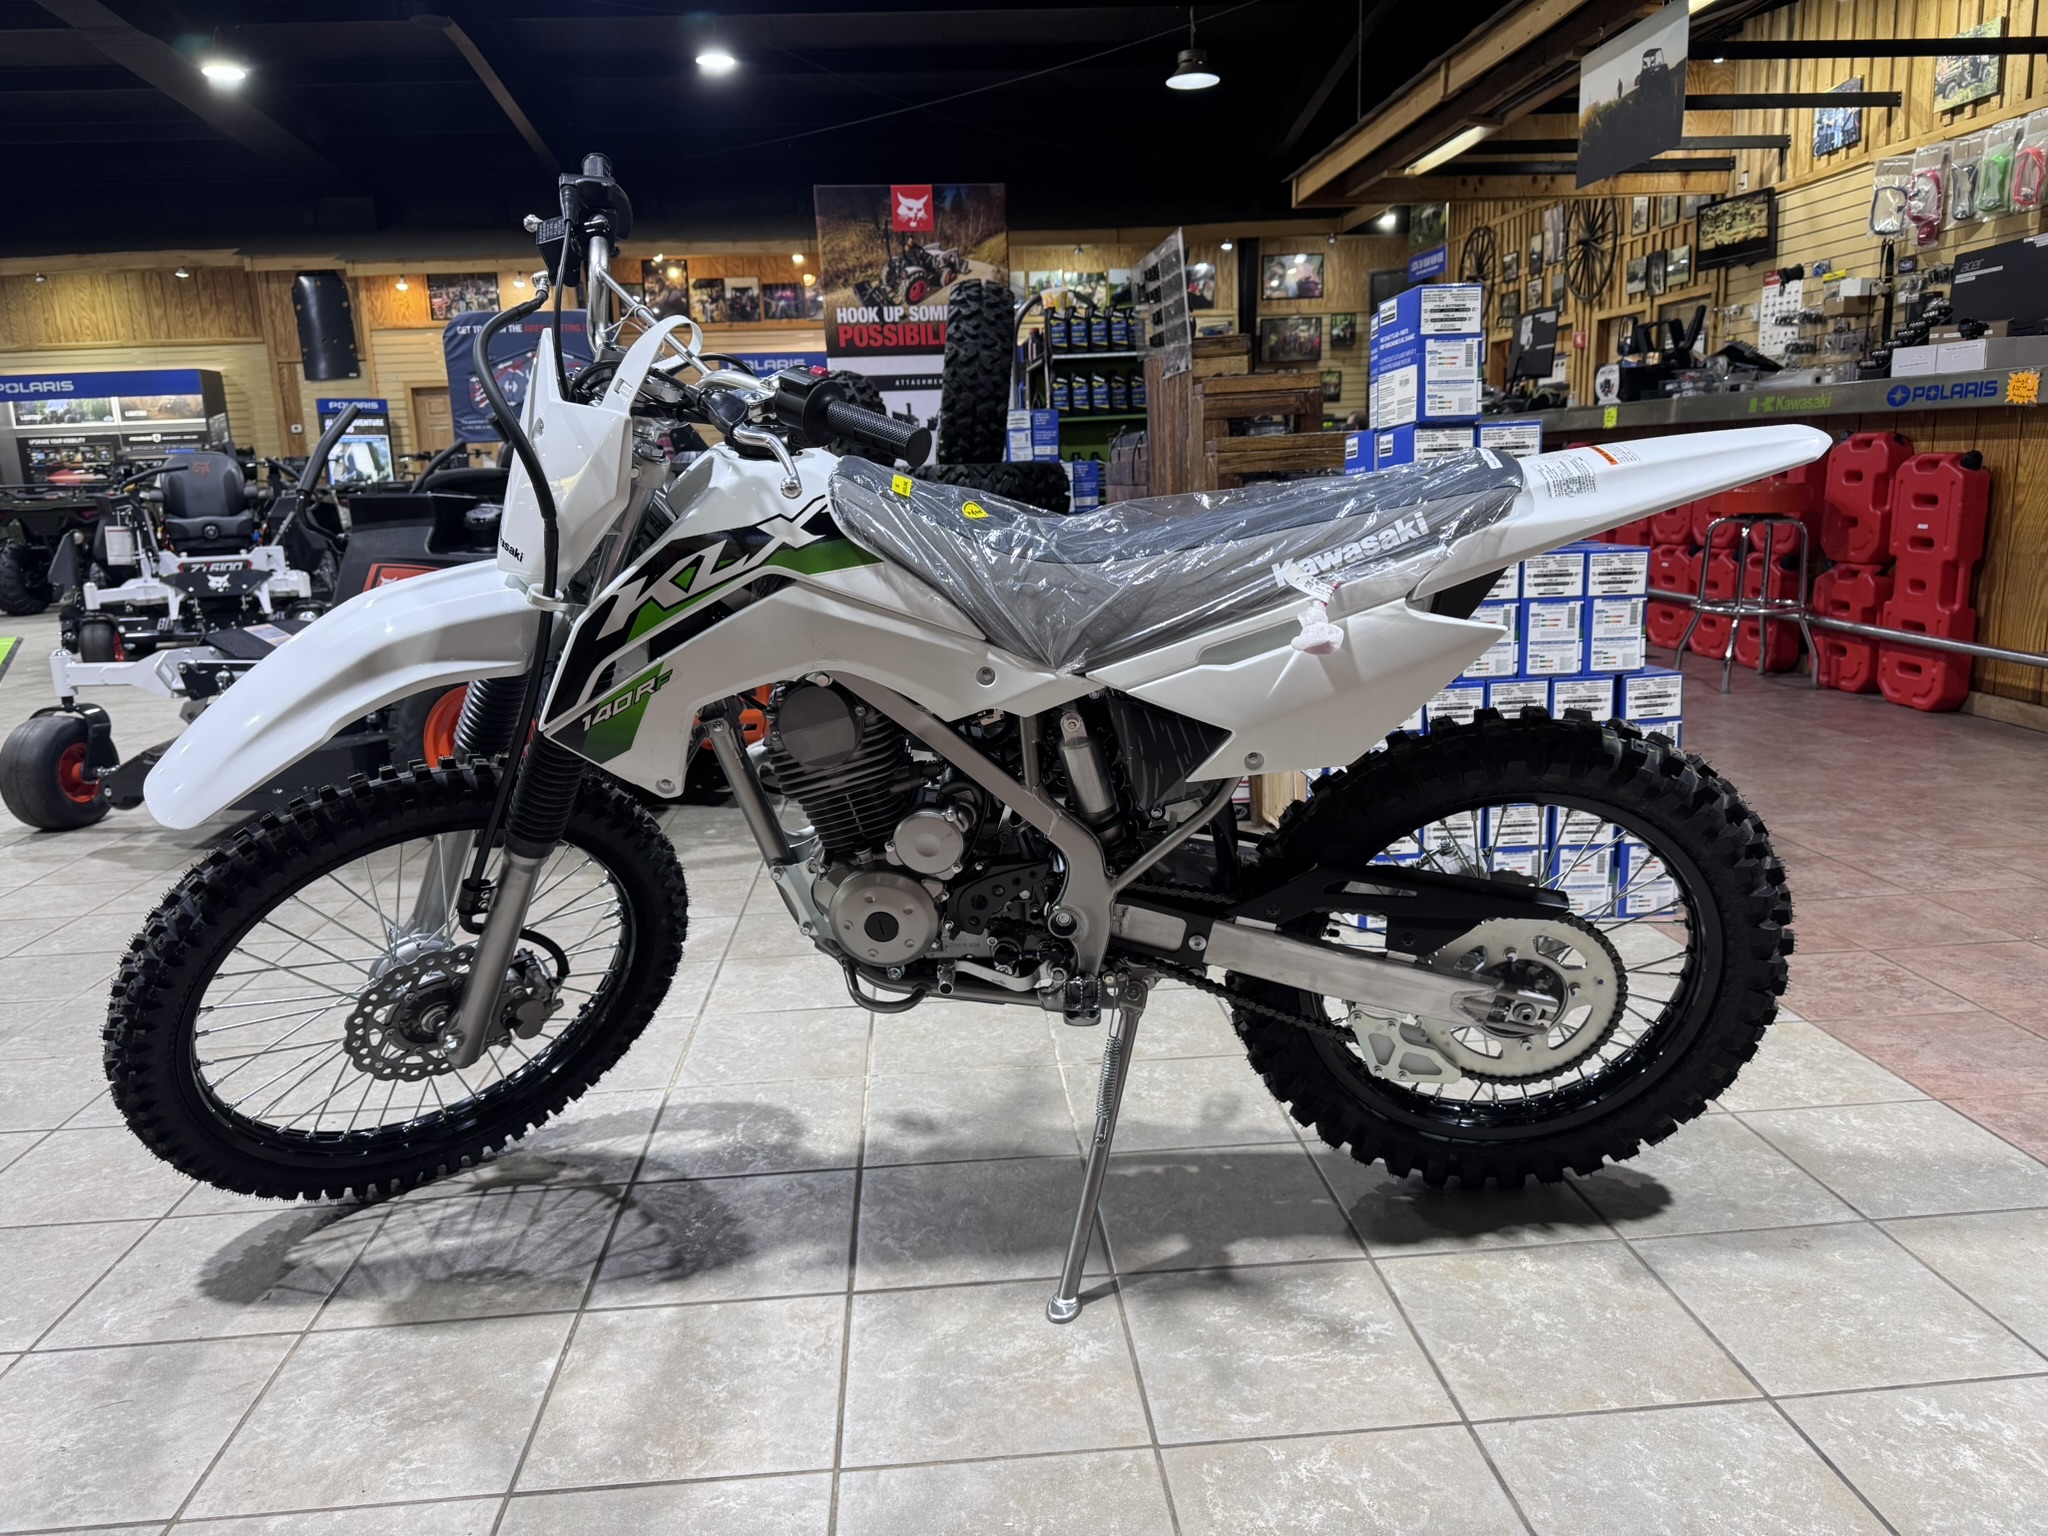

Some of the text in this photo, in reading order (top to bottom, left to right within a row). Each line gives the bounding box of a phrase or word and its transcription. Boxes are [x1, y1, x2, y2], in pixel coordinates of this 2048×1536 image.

[1960, 259, 1984, 273] acer
[836, 306, 880, 323] HOOK
[883, 305, 904, 322] UP
[457, 325, 471, 335] GET
[508, 324, 523, 333] THE
[728, 358, 806, 372] OLARIS
[1911, 380, 1998, 401] POLARIS
[1775, 392, 1832, 412] Kawasaki
[1271, 511, 1430, 588] Kawasaki
[597, 503, 827, 641] KLX
[581, 668, 675, 733] 140RF
